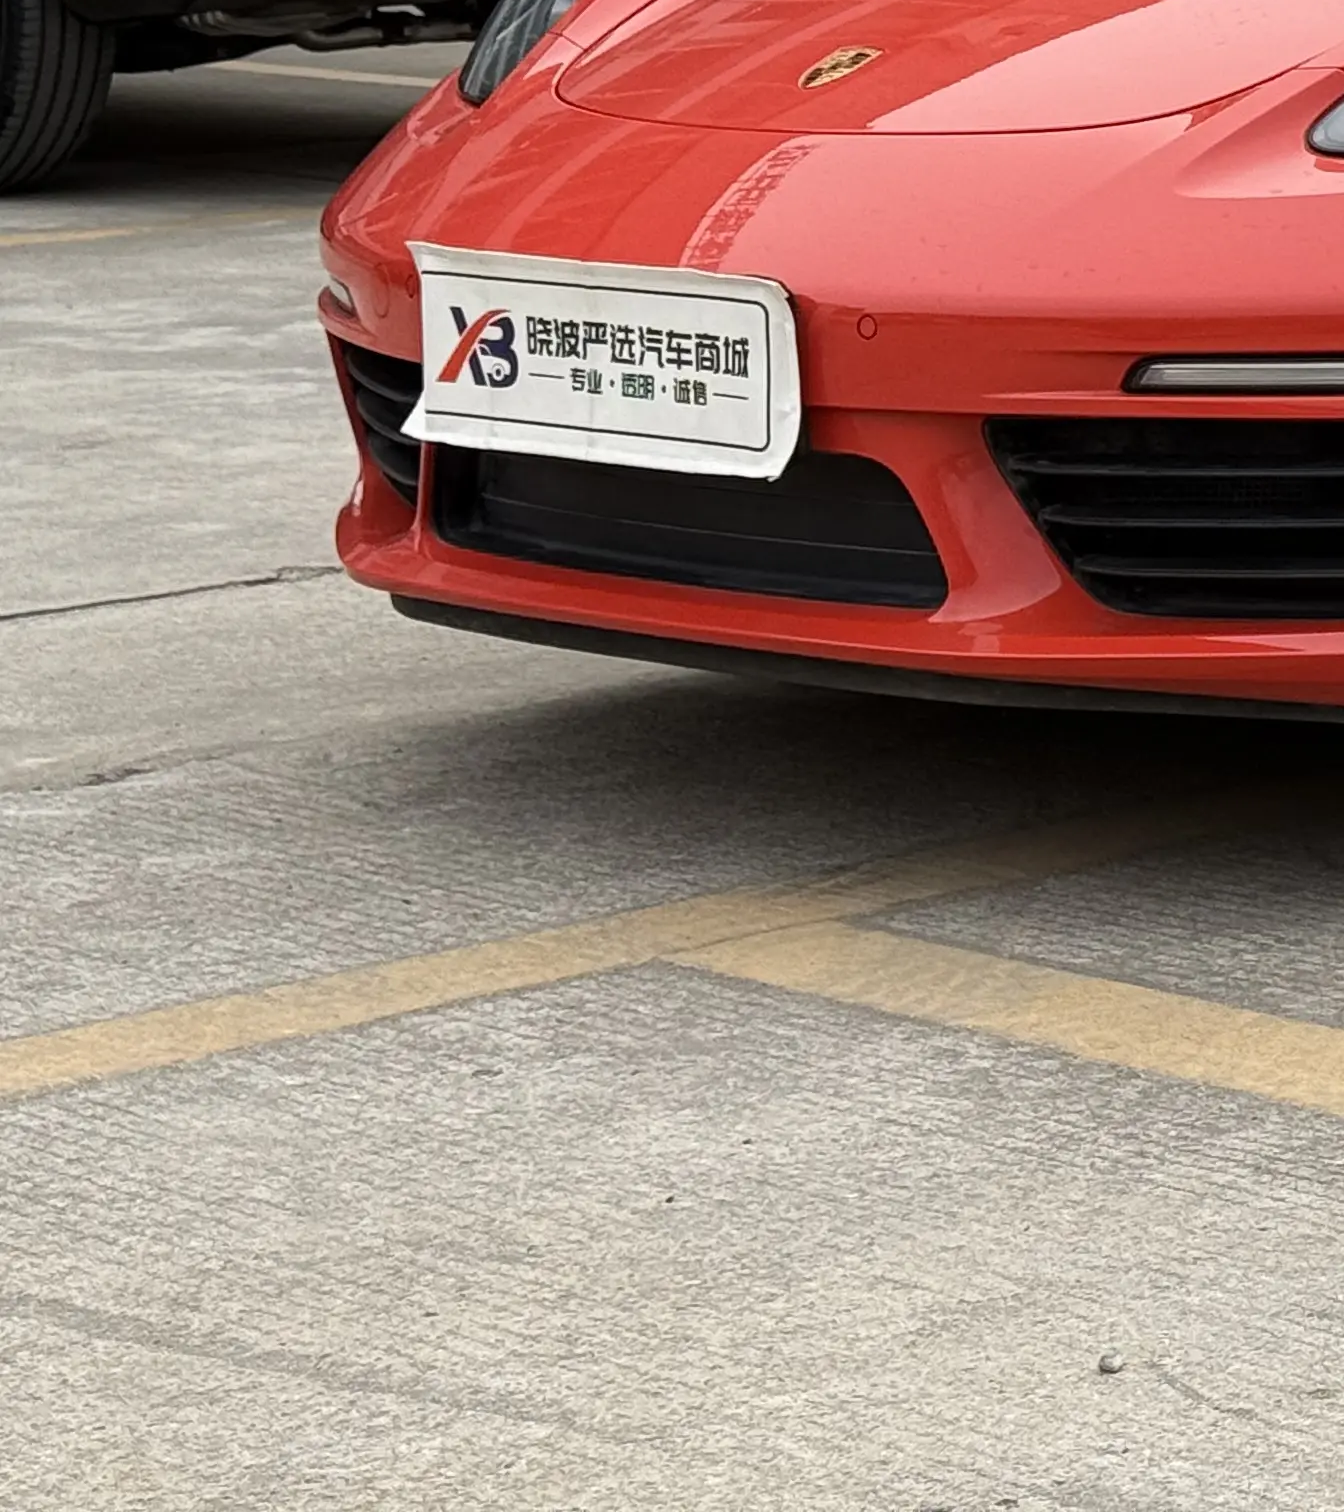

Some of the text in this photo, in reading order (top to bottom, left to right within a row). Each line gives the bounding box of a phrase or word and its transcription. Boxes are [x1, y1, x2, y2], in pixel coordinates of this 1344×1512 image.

[525, 315, 751, 380] 晓波严选汽车商城
